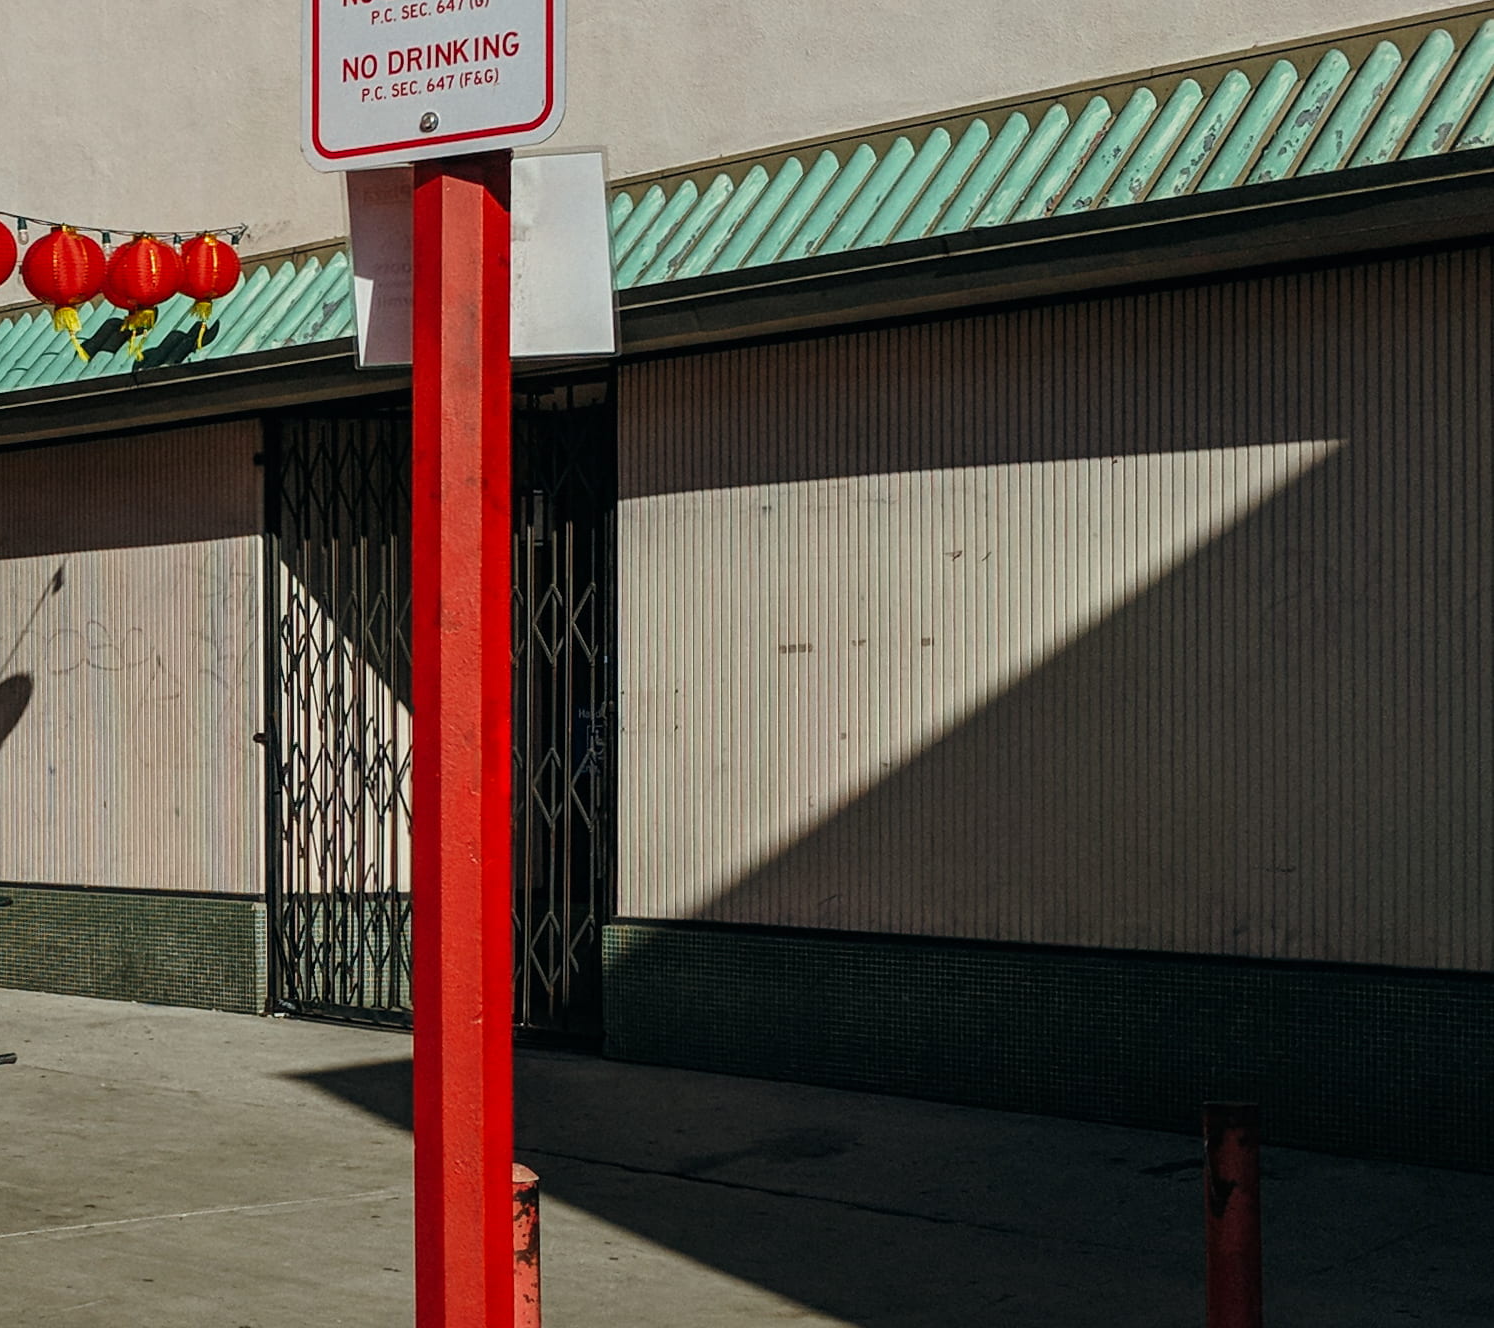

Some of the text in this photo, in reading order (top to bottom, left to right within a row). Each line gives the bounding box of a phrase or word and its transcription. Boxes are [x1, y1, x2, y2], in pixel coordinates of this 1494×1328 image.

[371, 8, 397, 25] P.C.
[401, 2, 432, 20] SEC.
[342, 31, 520, 83] NO DRINKING
[361, 67, 499, 102] P.C. SEC. 647 (F&G)
